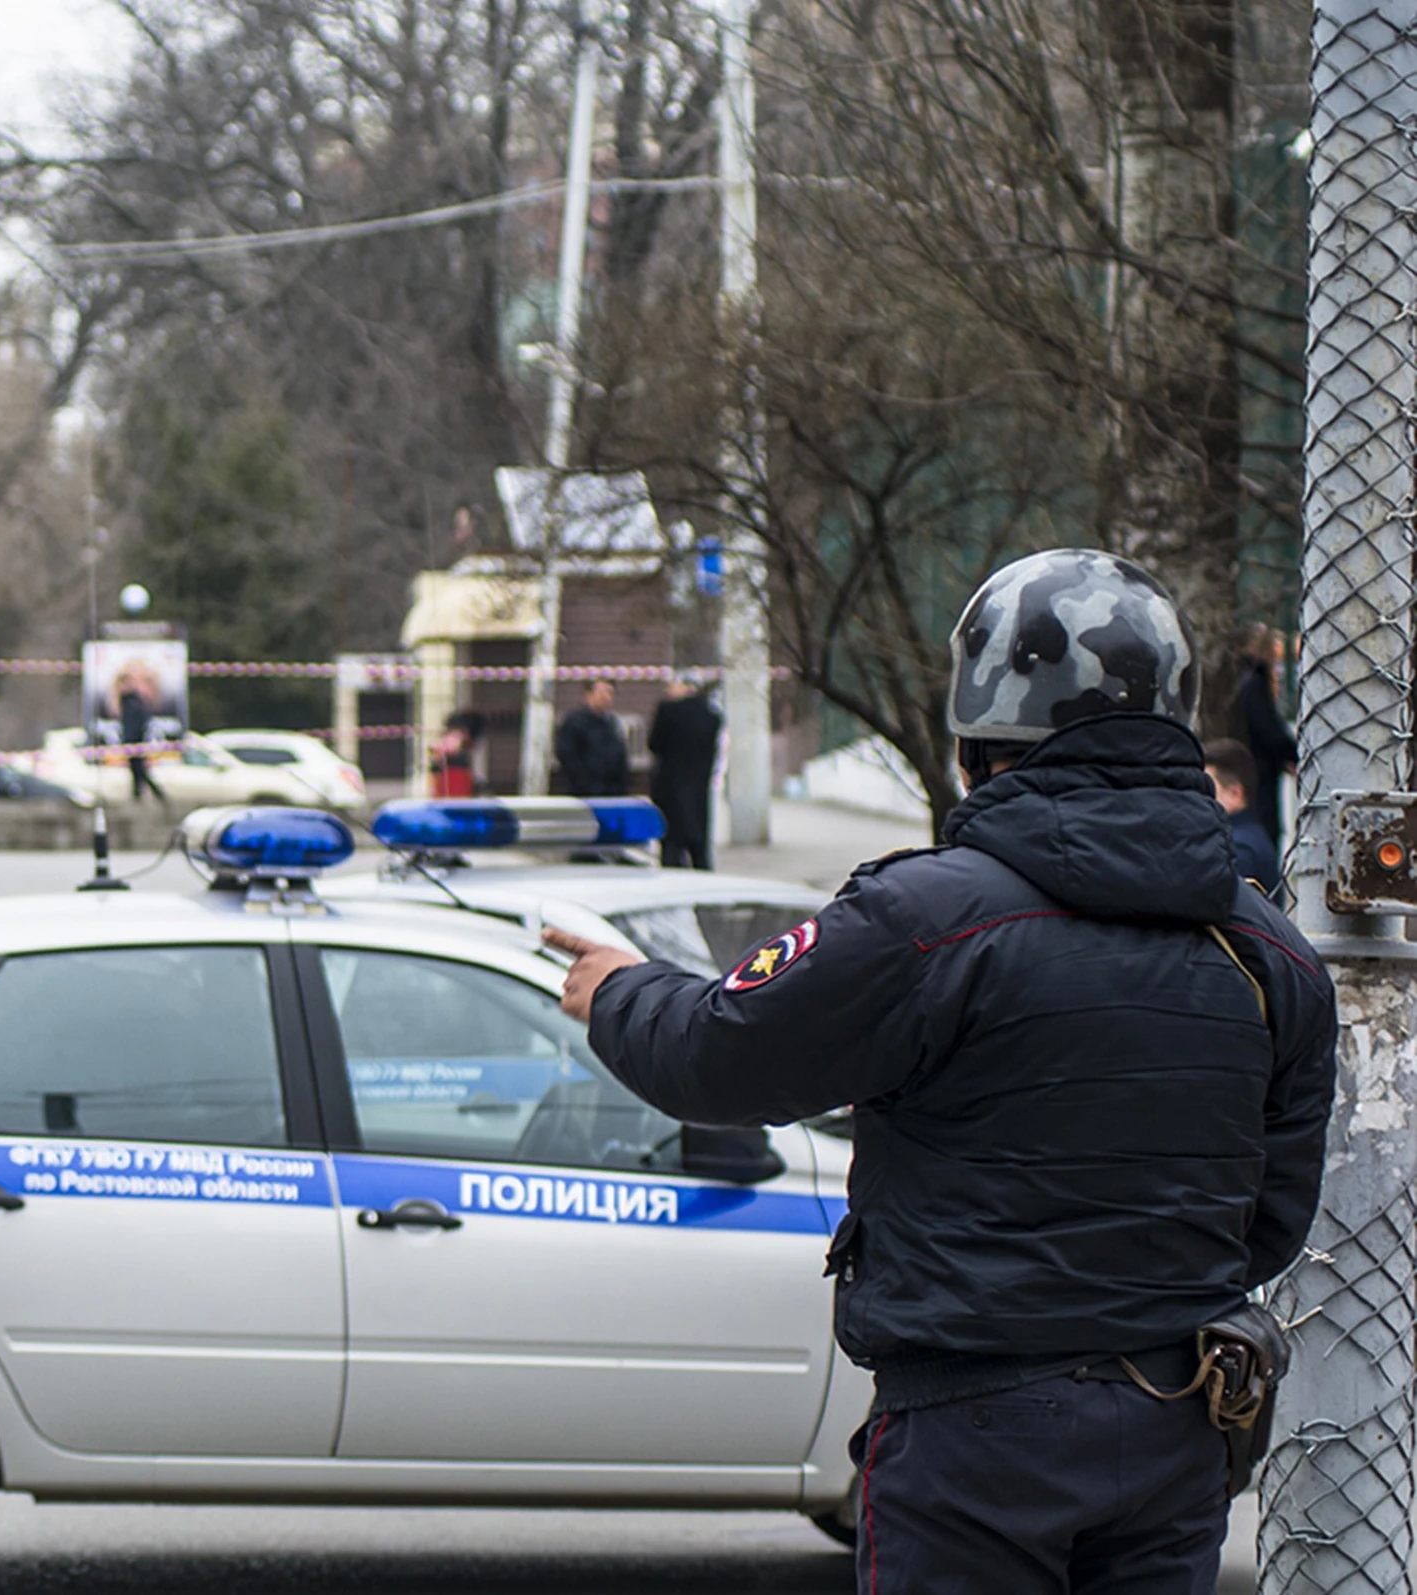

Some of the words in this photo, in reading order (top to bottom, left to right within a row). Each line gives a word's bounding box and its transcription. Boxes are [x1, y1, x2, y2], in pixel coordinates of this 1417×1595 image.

[9, 1146, 76, 1167] ФГКУ
[80, 1148, 131, 1169] УВО
[134, 1150, 165, 1171] ГУ
[168, 1152, 225, 1175] МВД
[228, 1154, 315, 1178] России
[25, 1173, 57, 1191] по
[60, 1170, 197, 1197] Ростовской
[201, 1176, 299, 1201] области
[460, 1174, 679, 1224] ПОЛИЦИЯ
